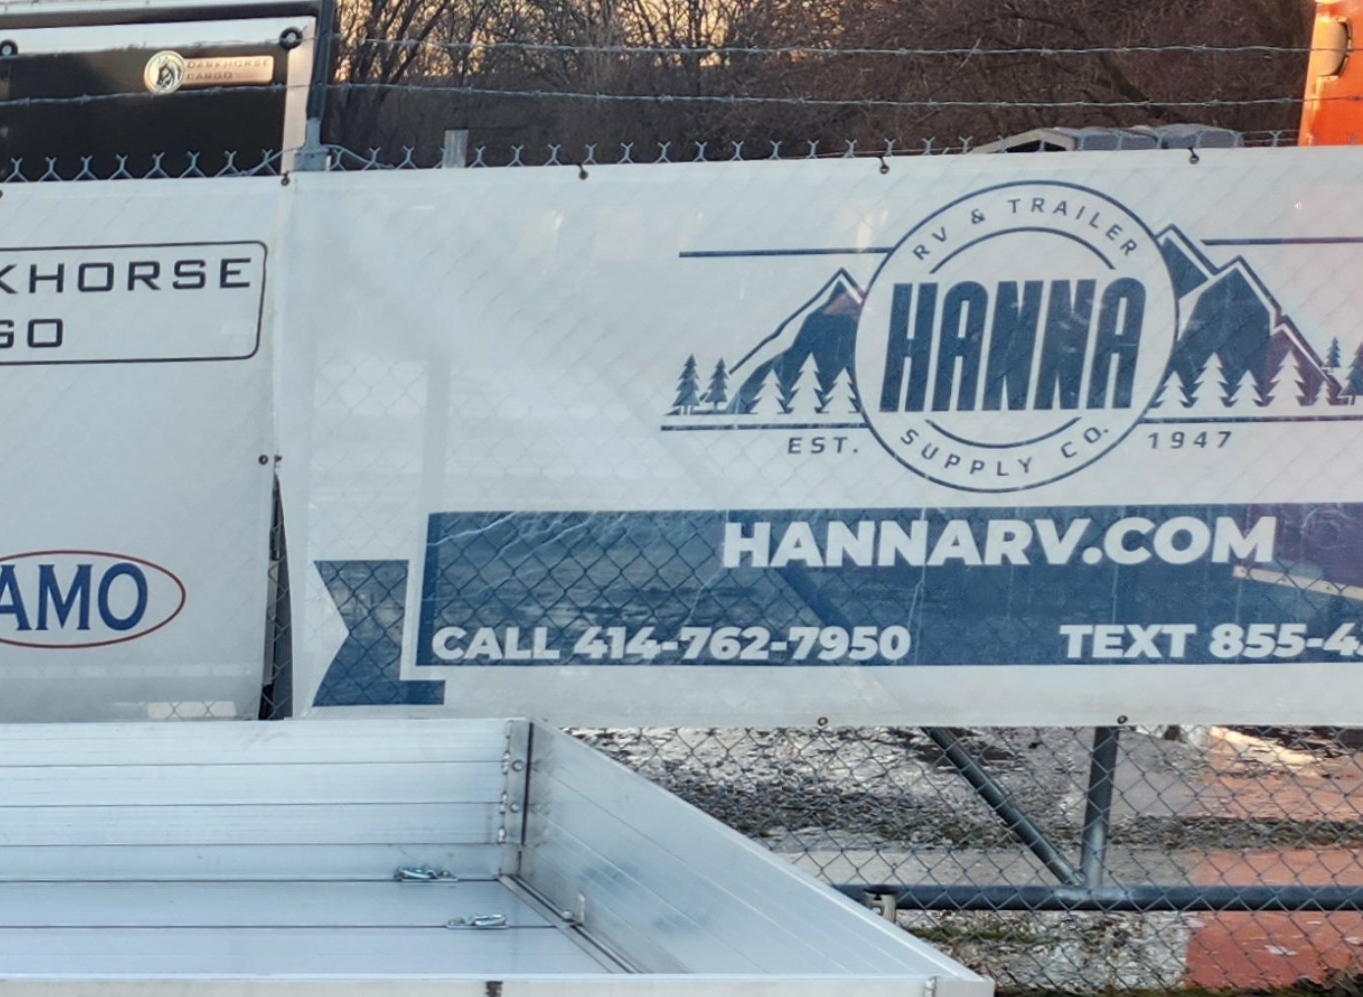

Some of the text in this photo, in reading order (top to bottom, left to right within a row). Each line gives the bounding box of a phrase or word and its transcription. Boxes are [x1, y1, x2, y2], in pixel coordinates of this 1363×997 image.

[187, 72, 234, 81] CARGO
[912, 197, 1140, 261] RV & TRAILER
[879, 276, 1148, 413] HANNA
[786, 430, 1233, 455] EST. 1947
[900, 426, 1111, 477] SUPPLY CO.
[722, 517, 1277, 571] HANNARV.COM
[431, 626, 912, 663] CALL 414-762-7950
[1060, 622, 1363, 660] TEXT 855-4
